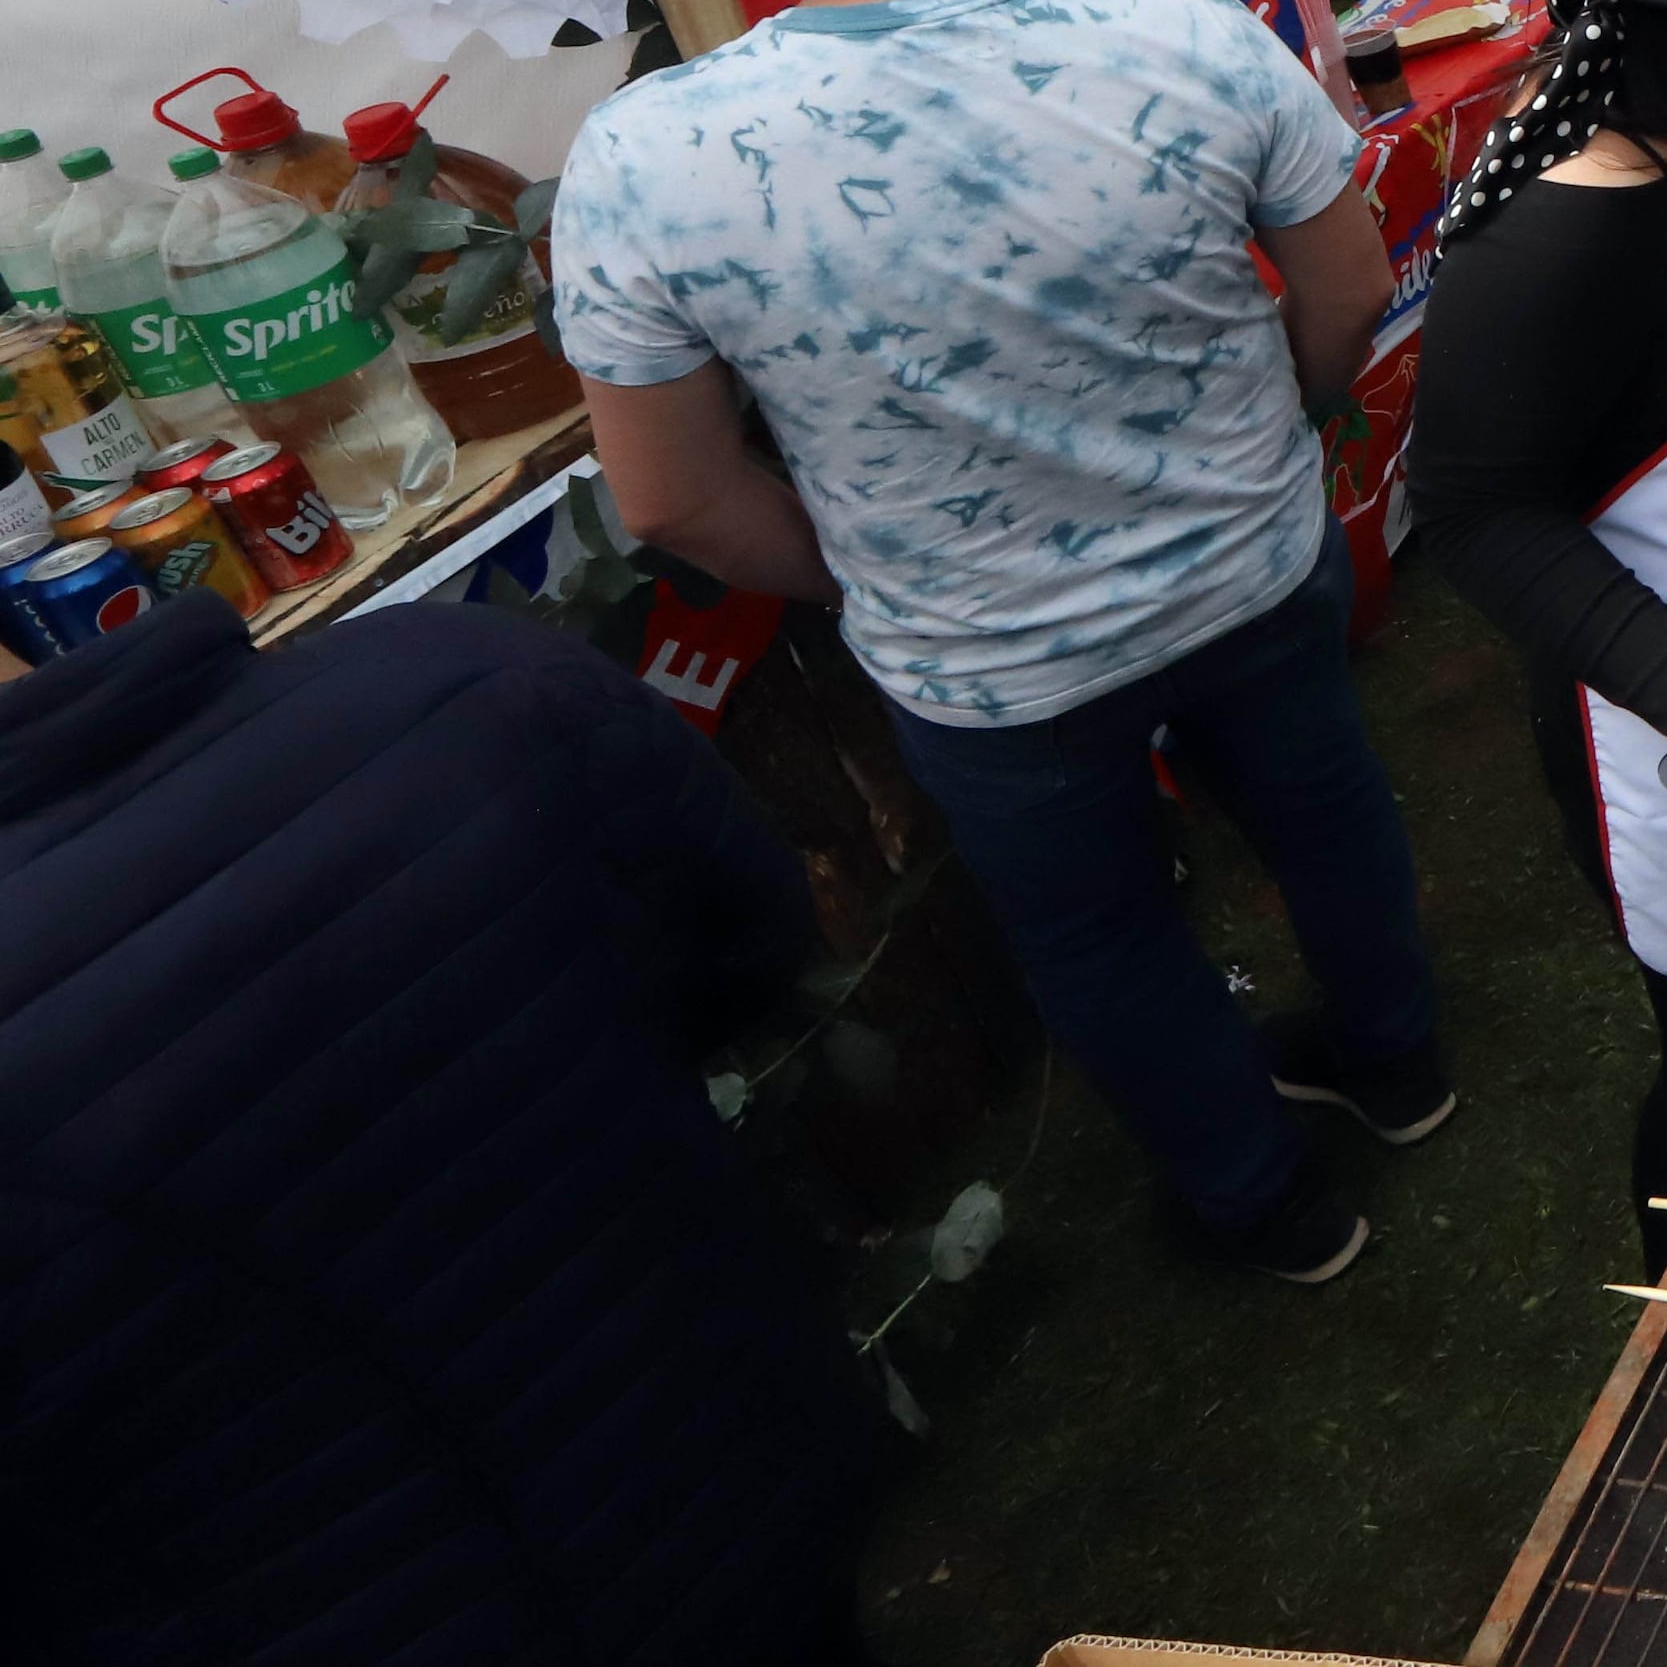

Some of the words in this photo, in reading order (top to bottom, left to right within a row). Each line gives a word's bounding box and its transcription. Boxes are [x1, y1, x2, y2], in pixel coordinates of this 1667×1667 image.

[223, 280, 356, 361] Sprite
[80, 431, 147, 476] CARMEN
[83, 412, 121, 446] ALTO
[265, 491, 333, 555] Bil
[158, 542, 213, 593] ush
